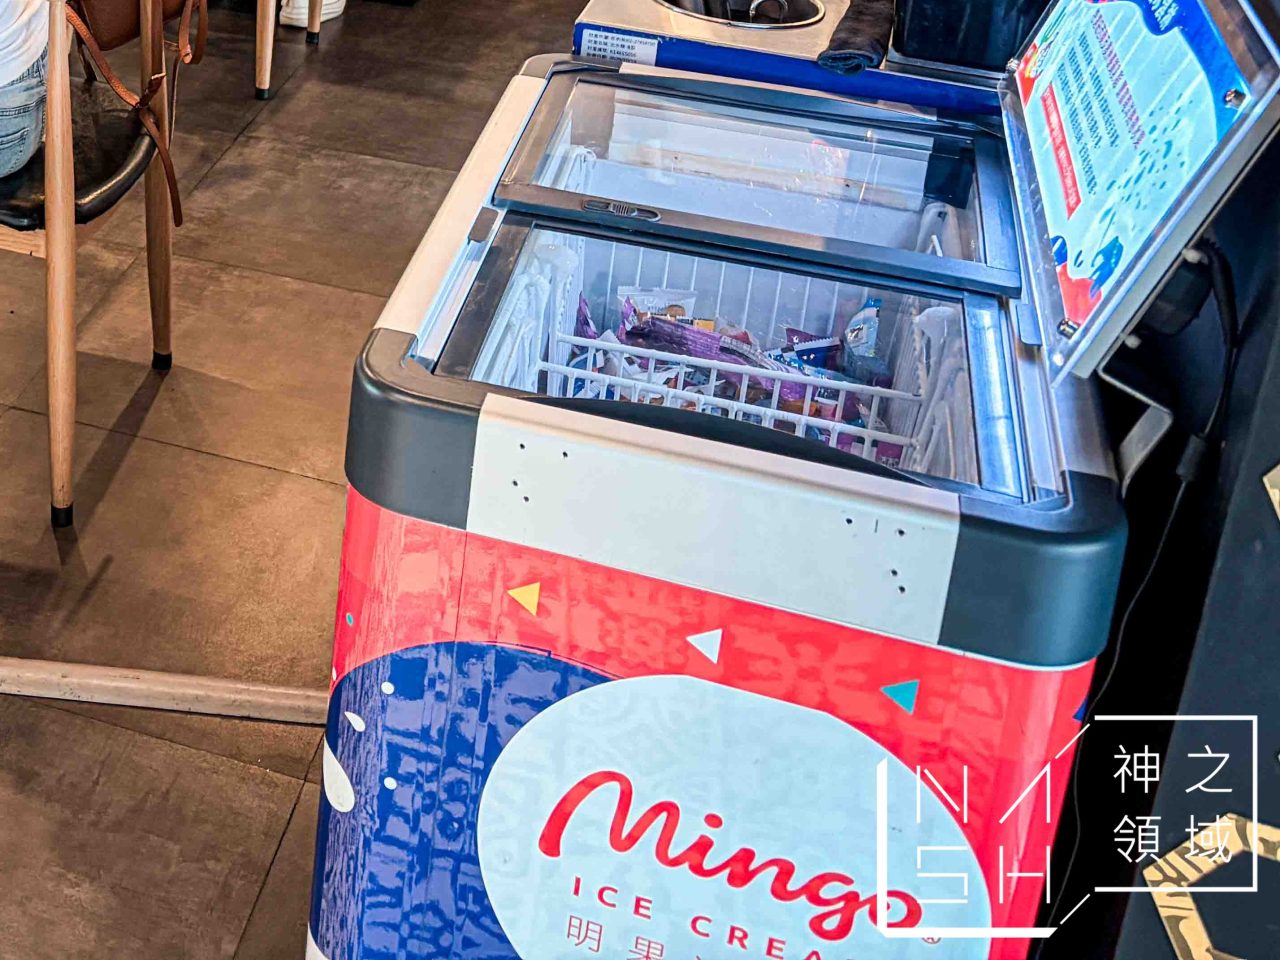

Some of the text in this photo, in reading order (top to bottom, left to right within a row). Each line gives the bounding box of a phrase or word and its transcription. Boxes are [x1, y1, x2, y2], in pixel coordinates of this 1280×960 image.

[538, 770, 922, 941] Mingo
[572, 876, 854, 960] ICE CREA
